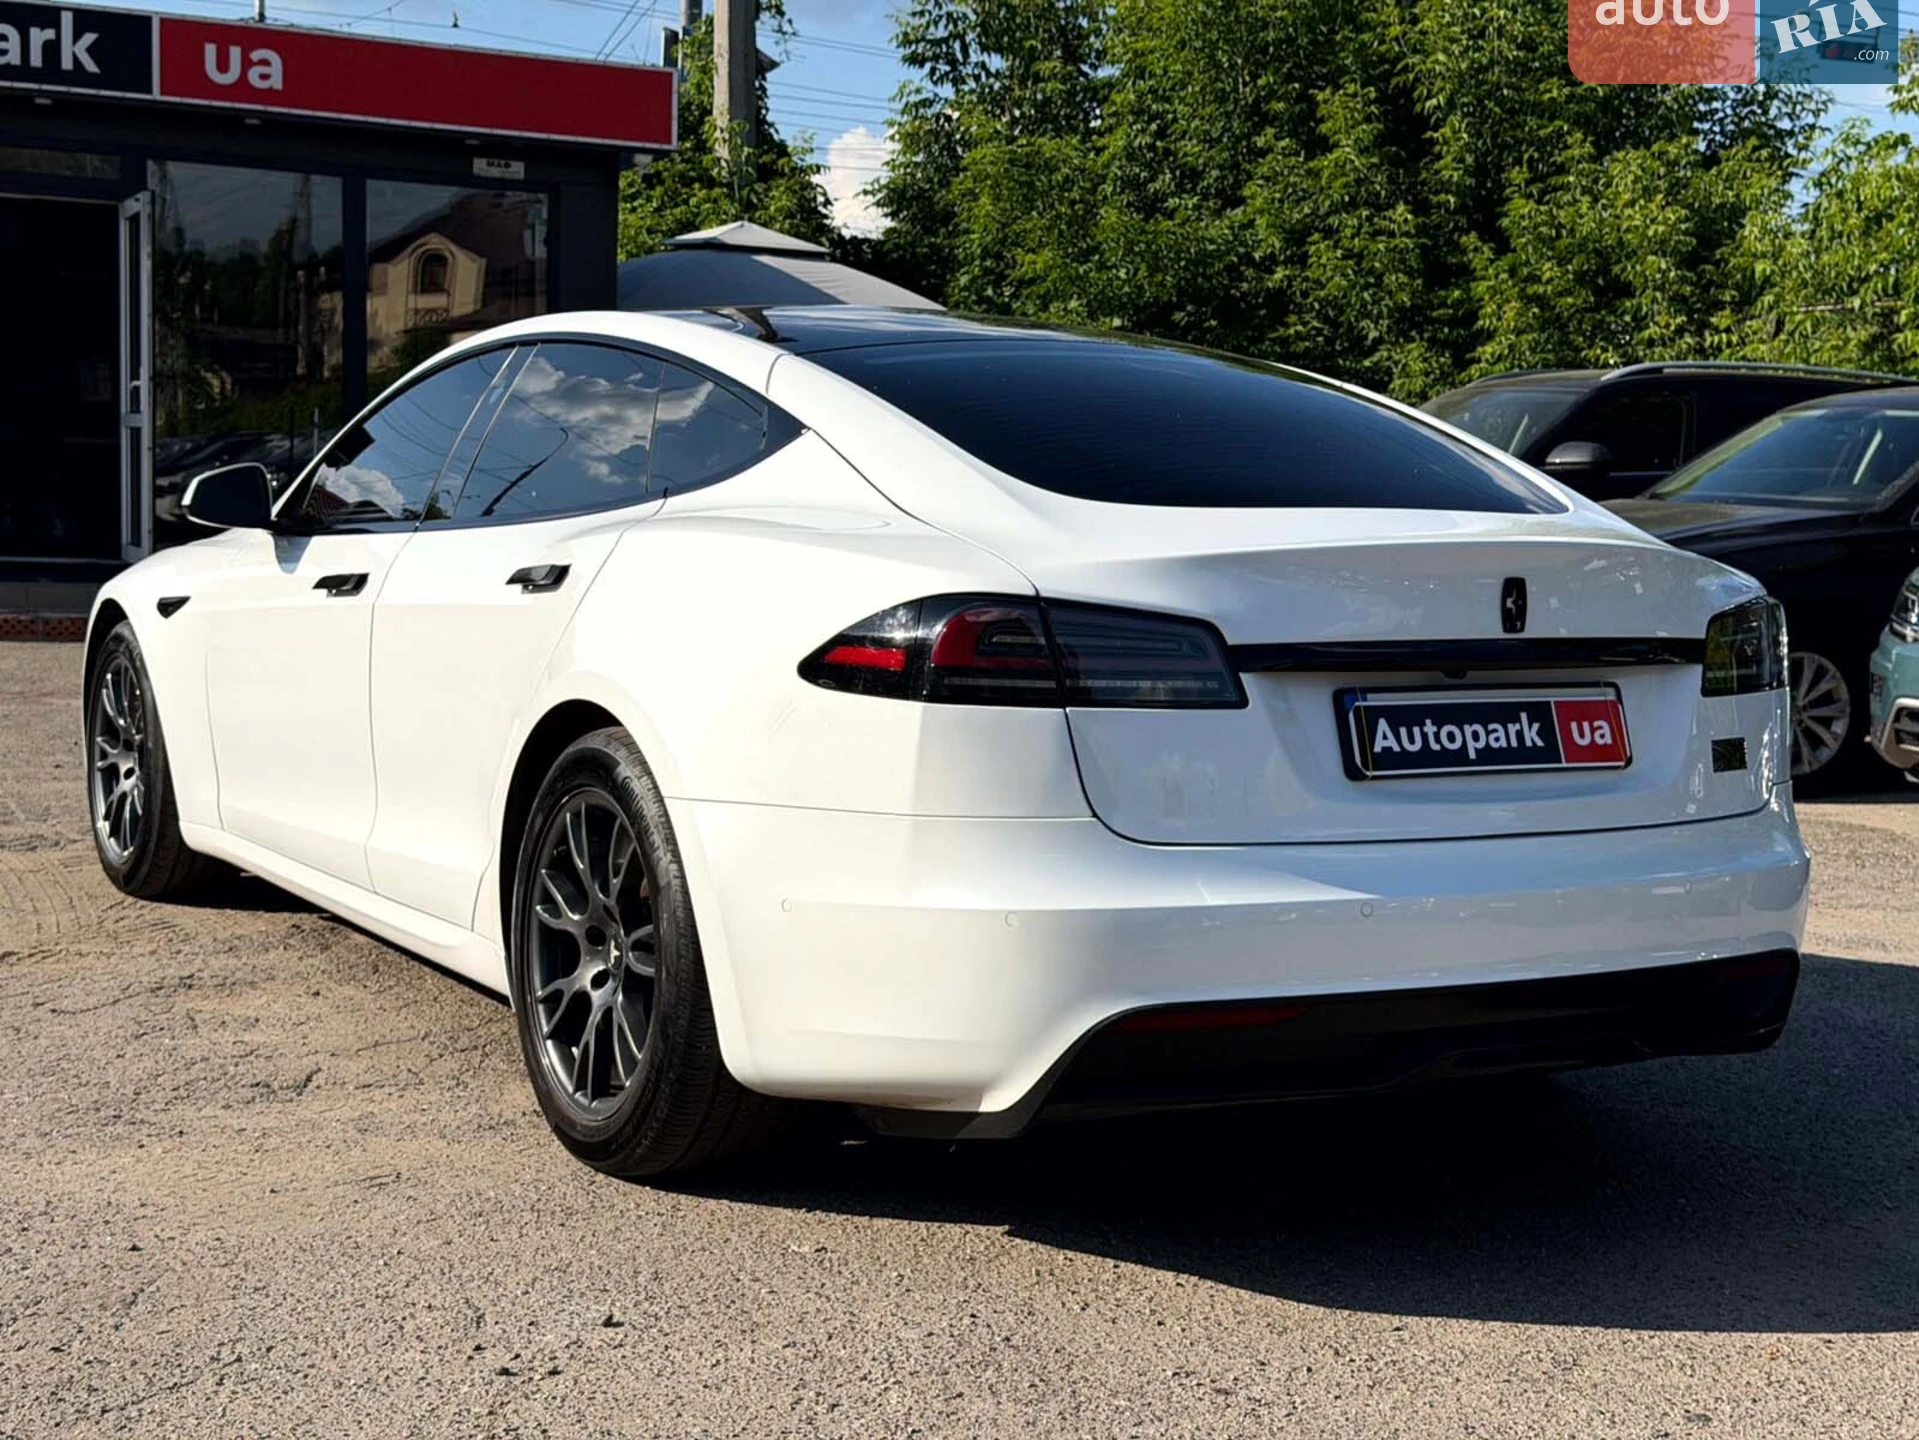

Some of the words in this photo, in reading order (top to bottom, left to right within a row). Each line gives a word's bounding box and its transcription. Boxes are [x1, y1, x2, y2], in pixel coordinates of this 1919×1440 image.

[204, 43, 283, 90] ua
[1373, 712, 1544, 759] Autopark
[1570, 719, 1612, 746] ua
